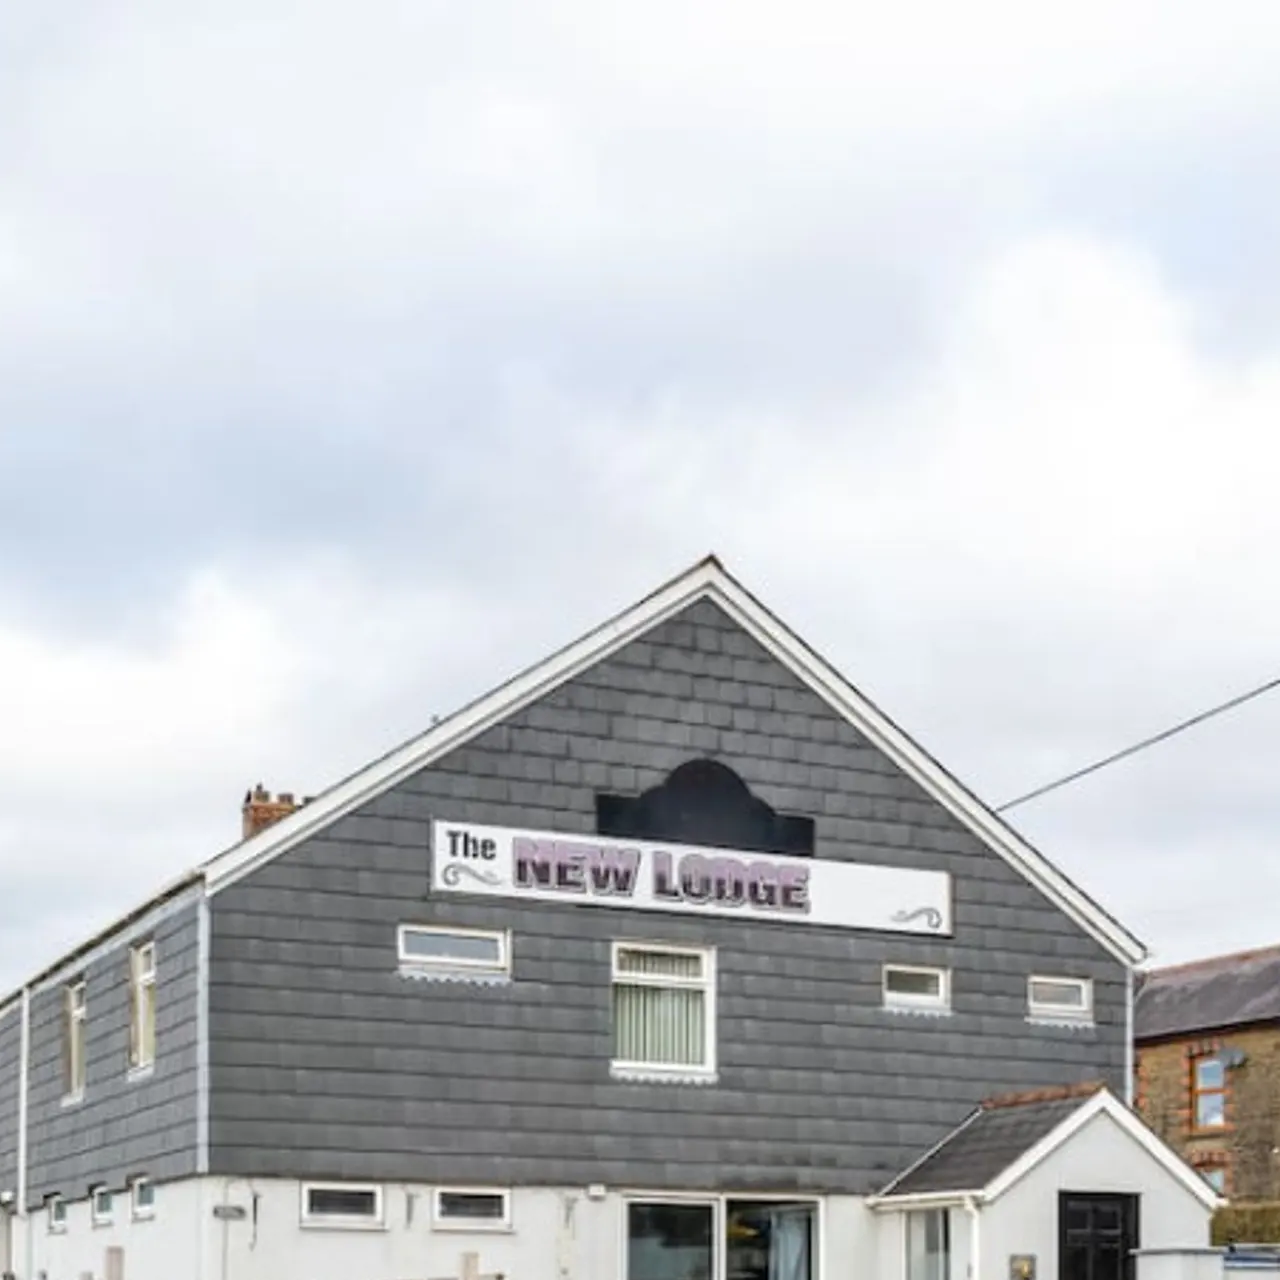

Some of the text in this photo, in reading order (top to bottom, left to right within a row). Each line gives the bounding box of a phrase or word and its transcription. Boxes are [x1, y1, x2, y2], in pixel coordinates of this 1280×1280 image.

[446, 832, 811, 914] The NEW LODGE
